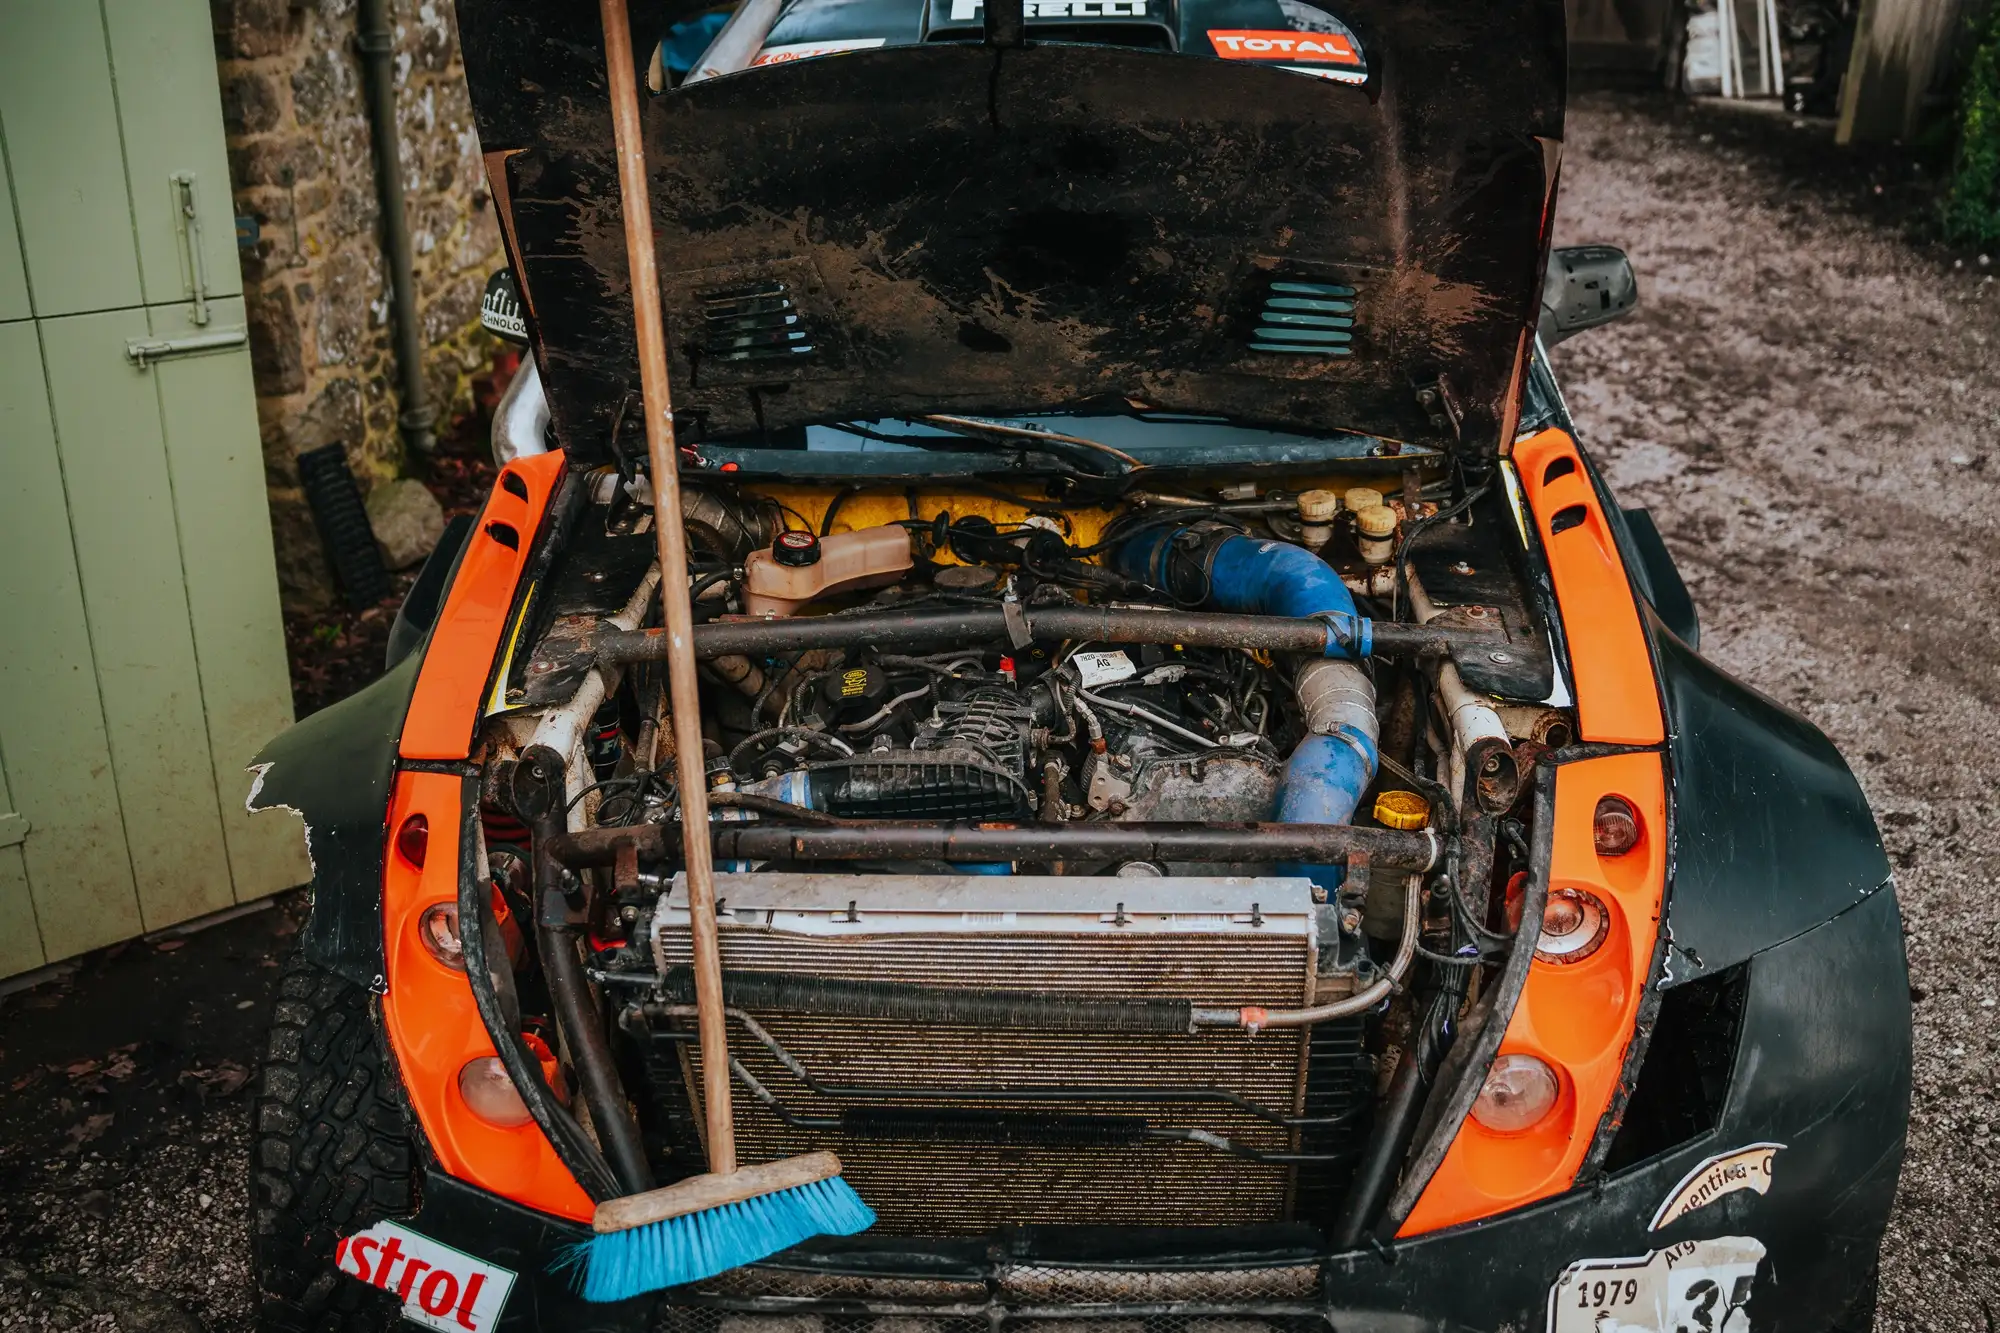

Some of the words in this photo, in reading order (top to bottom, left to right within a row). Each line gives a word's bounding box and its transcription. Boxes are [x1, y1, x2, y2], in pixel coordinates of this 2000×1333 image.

[1215, 36, 1350, 56] TOTAL
[1096, 658, 1111, 668] AG
[1577, 1278, 1638, 1308] 1979
